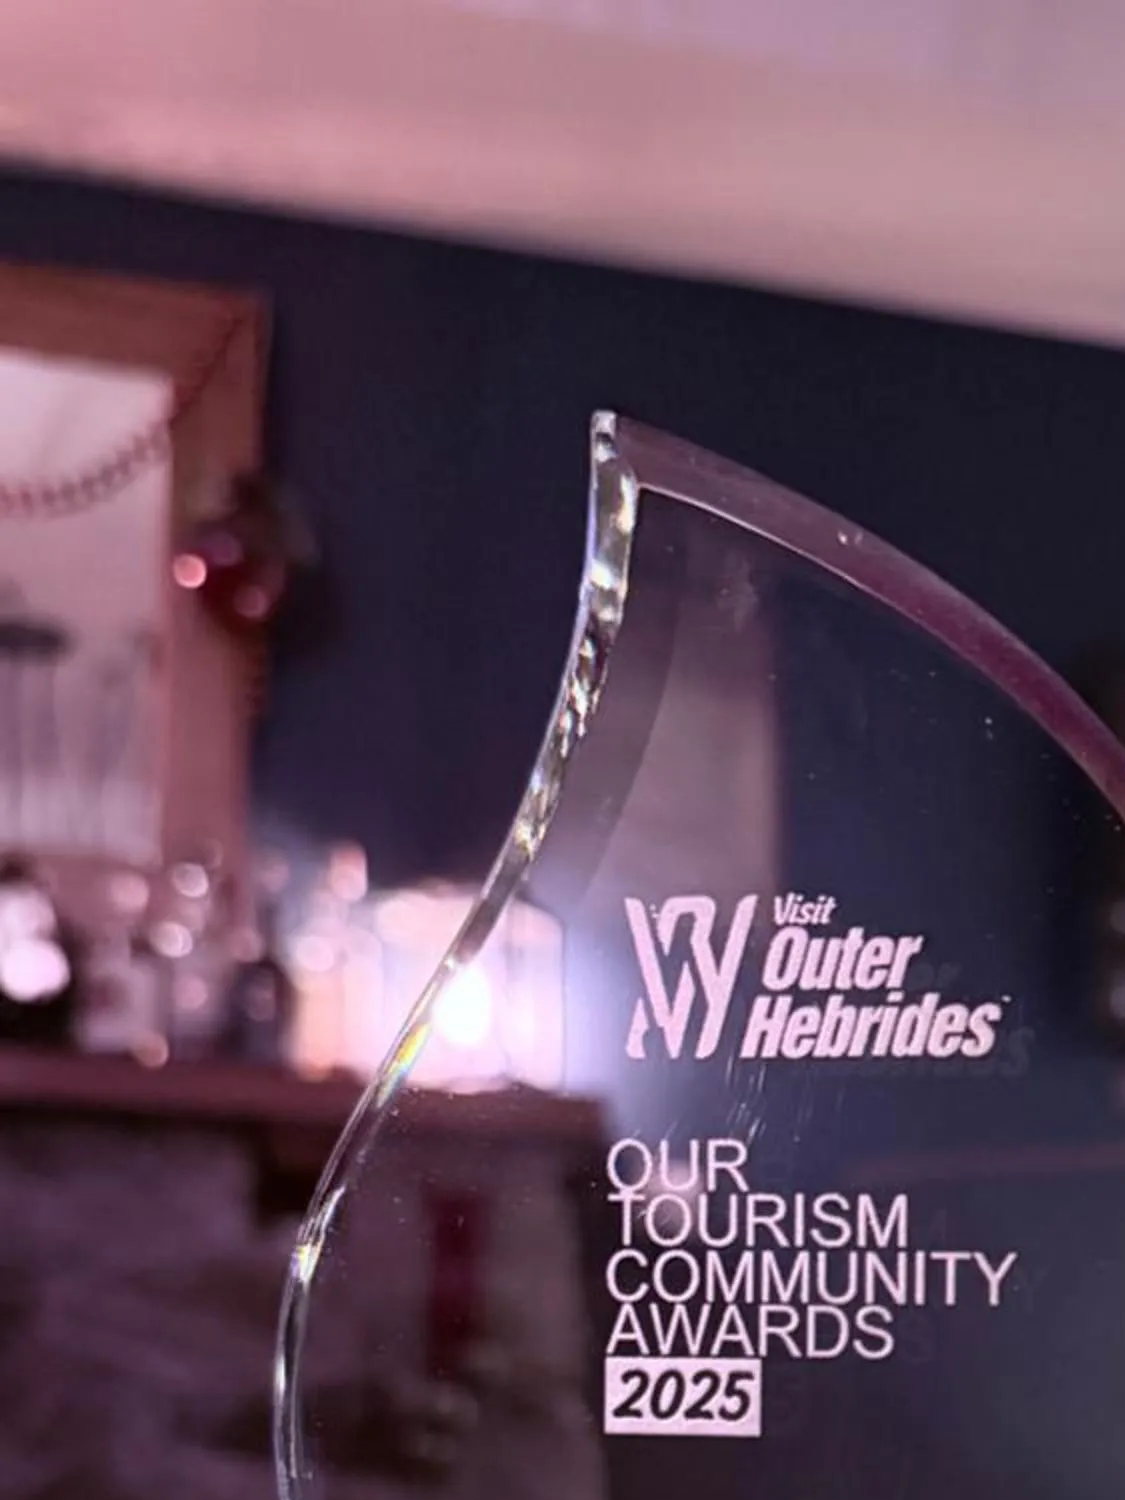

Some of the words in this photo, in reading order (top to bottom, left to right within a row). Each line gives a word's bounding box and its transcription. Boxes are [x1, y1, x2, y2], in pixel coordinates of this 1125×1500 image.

[773, 892, 836, 926] Visit
[762, 926, 923, 990] Outer
[741, 991, 1002, 1060] Hebrides
[607, 1138, 749, 1192] OUR
[608, 1194, 908, 1248] TOURISM
[606, 1250, 1016, 1305] COMMUNITY
[606, 1304, 895, 1359] AWARDS
[612, 1369, 755, 1420] 2025
